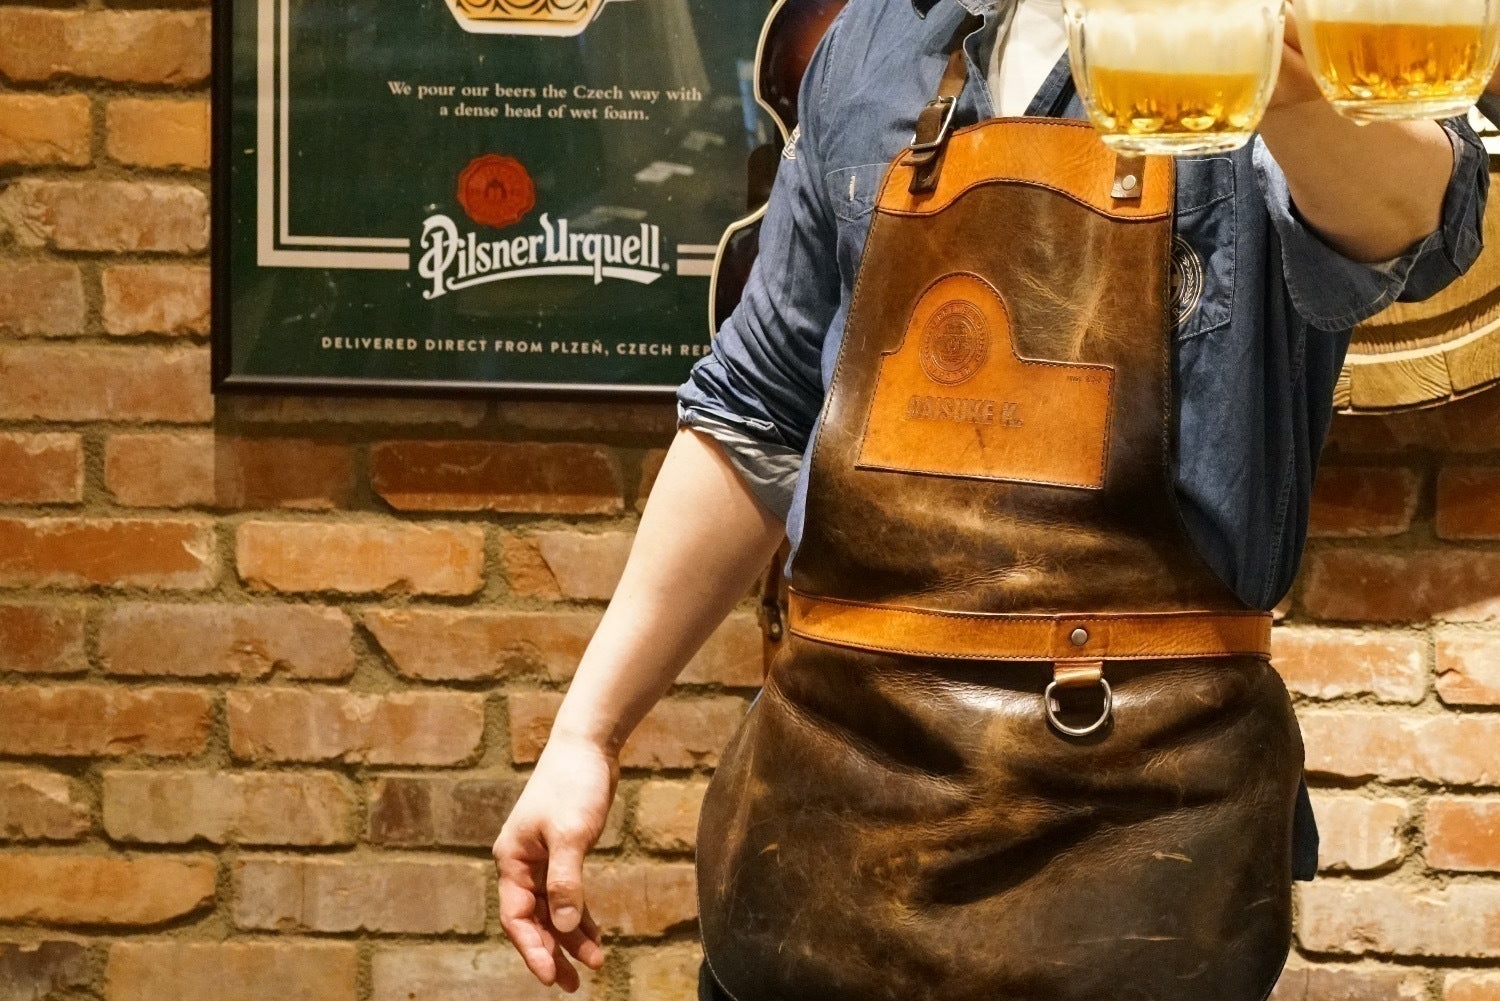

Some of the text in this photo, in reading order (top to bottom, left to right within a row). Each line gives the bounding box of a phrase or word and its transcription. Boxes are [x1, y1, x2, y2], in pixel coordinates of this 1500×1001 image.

[387, 80, 703, 104] We pour our beers the Czech way with
[440, 102, 650, 121] a dense head of wet foam.
[418, 211, 662, 301] Pilsner Urquell
[321, 336, 418, 350] DELIVERED
[425, 339, 488, 352] DIRECT
[495, 341, 543, 353] FROM
[551, 338, 610, 356] PLZEŇ,
[617, 342, 674, 356] CZECH
